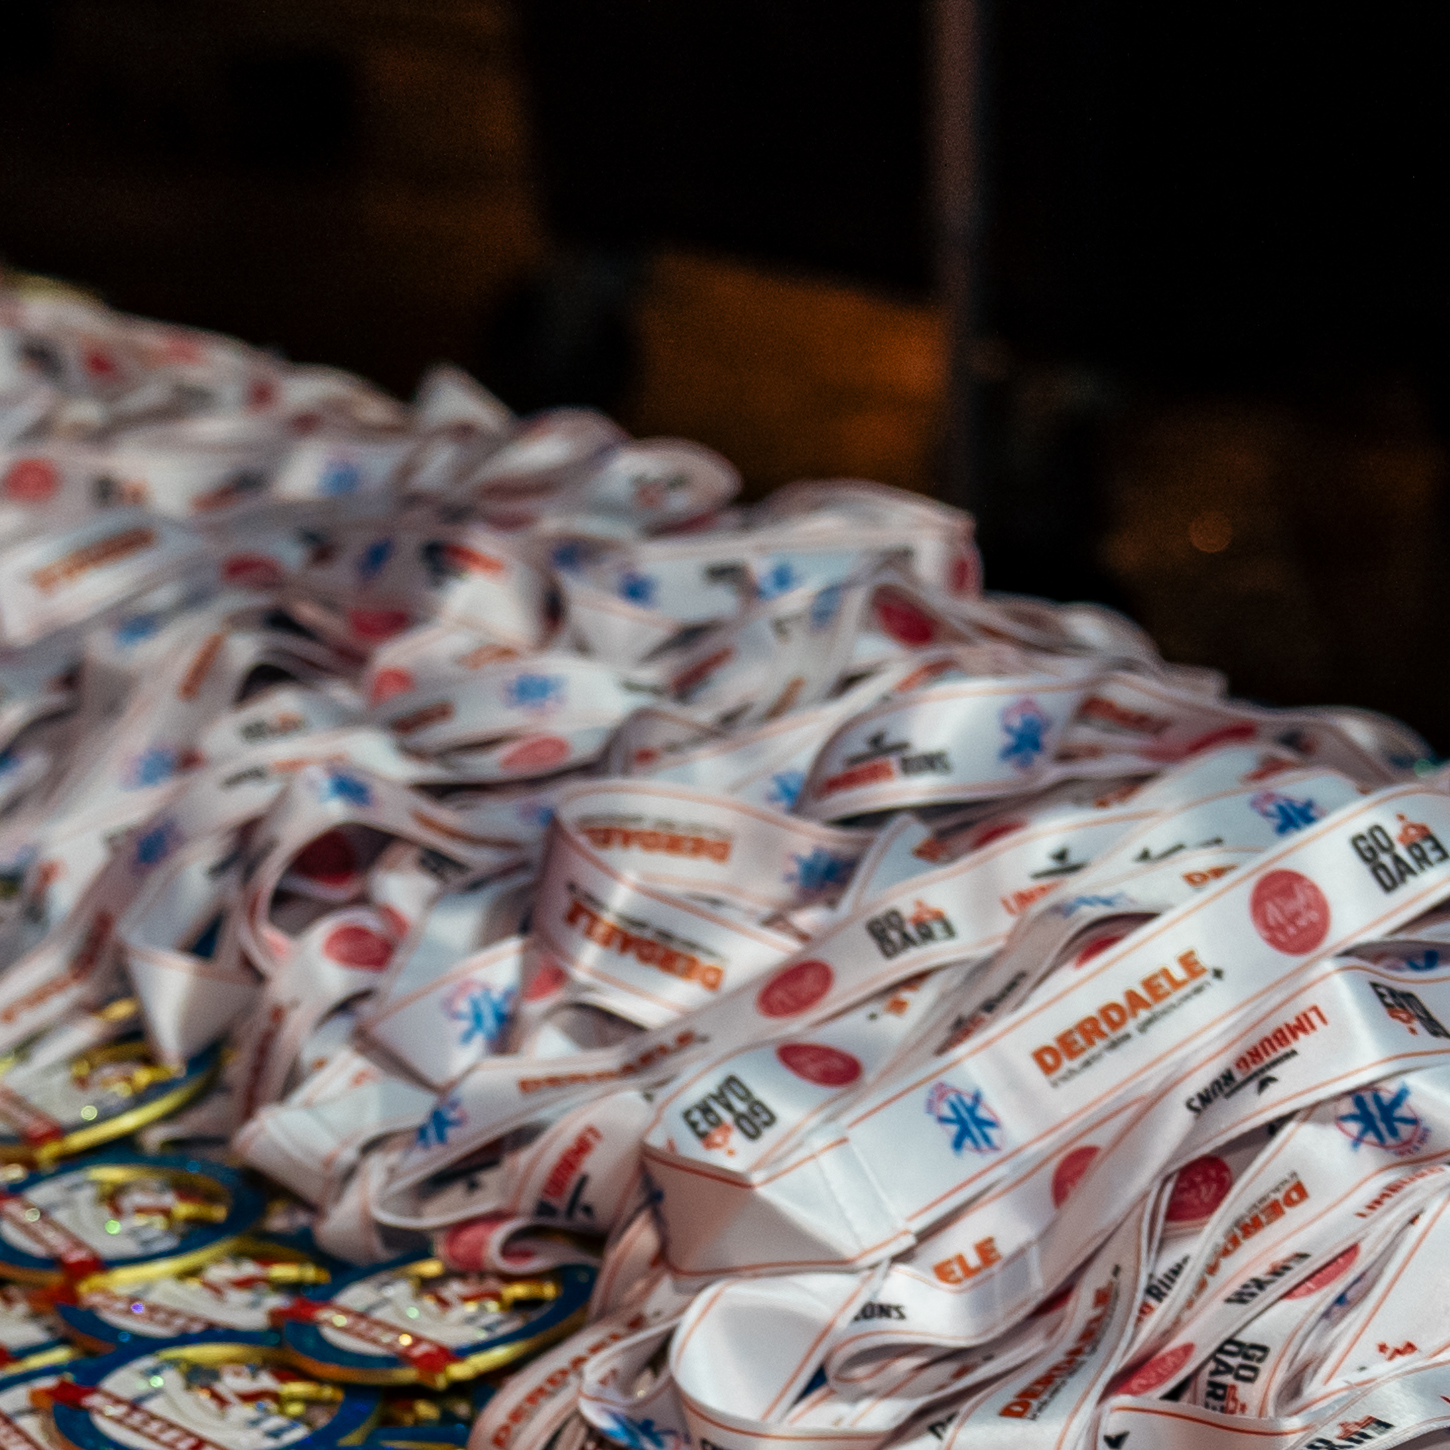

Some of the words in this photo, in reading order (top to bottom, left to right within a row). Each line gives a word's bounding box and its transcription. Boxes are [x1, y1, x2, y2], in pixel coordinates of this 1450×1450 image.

[1349, 824, 1395, 866] GO
[1031, 948, 1210, 1077] DERDAELE
[1235, 1004, 1330, 1074] LIMBURG
[682, 1074, 752, 1140] DARE
[1184, 1067, 1237, 1114] RUNS
[734, 1100, 778, 1141] GO
[1237, 1339, 1271, 1385] GO
